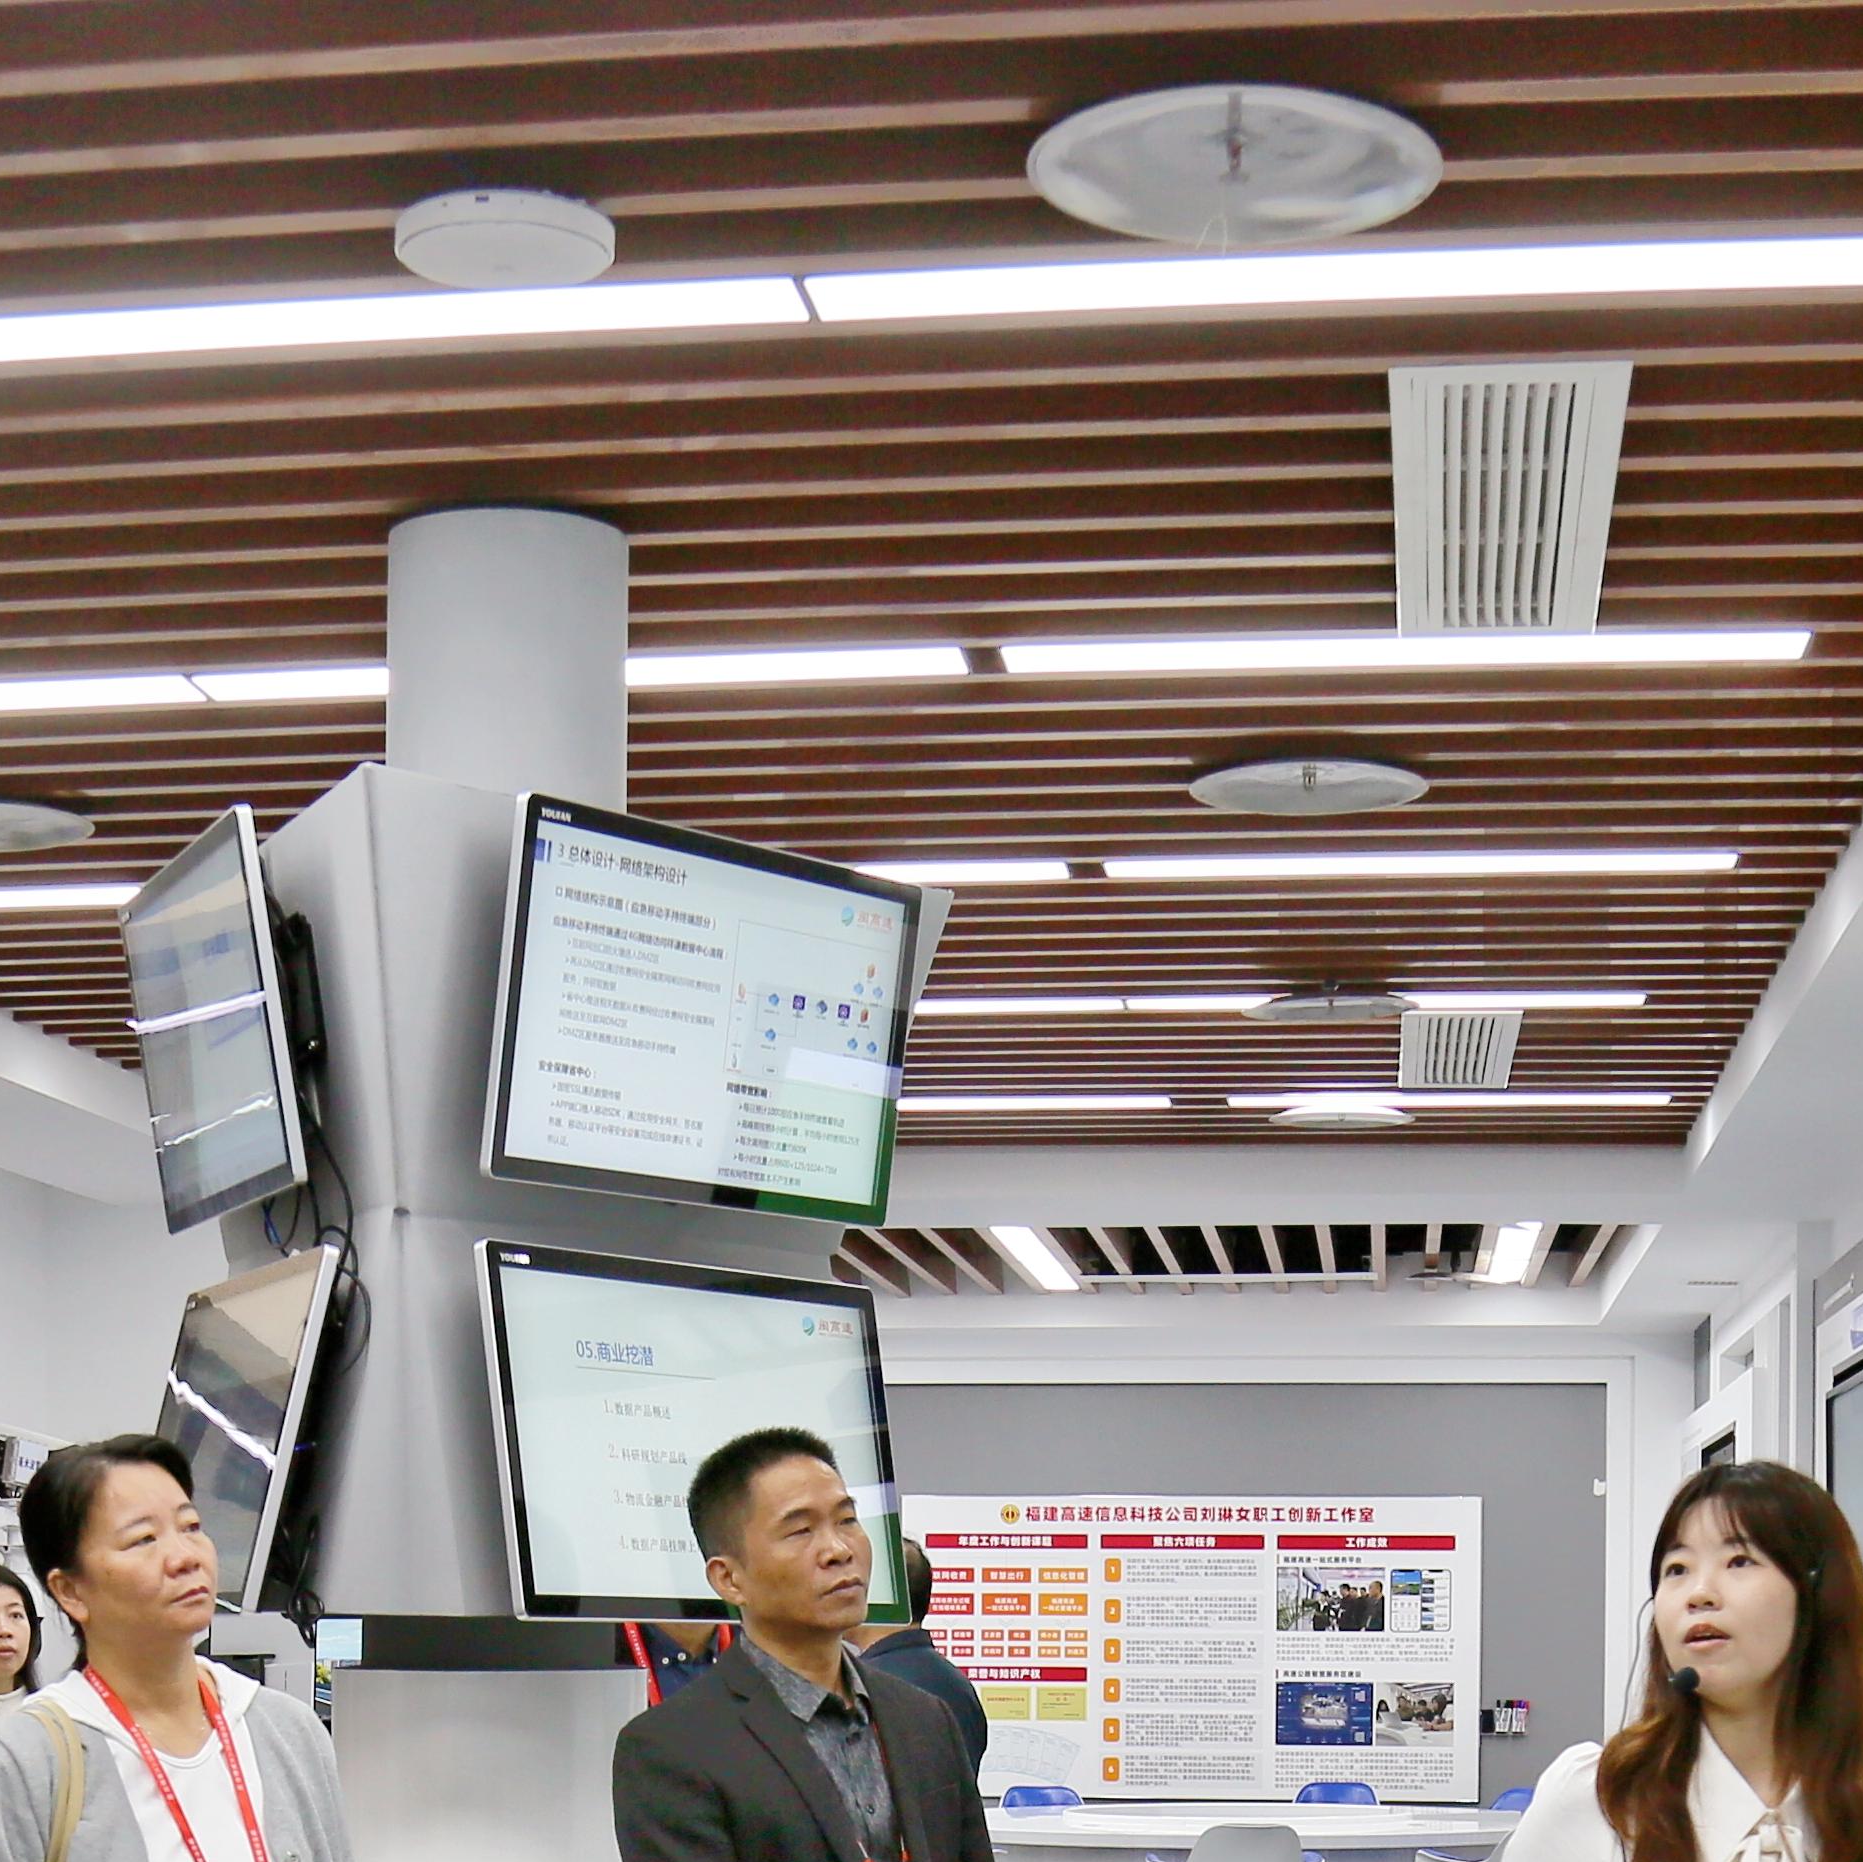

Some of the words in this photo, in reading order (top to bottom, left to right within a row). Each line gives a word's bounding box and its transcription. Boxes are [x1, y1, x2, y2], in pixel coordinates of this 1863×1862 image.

[569, 847, 688, 886] 总体设计-网络架构设计
[576, 1340, 654, 1367] 05.商业挖潜
[1026, 1505, 1375, 1524] 福建高速信息科技公司刘琳女职工创新工作室
[958, 1535, 1052, 1547] 年度工作与创新课题
[1152, 1535, 1216, 1549] 聚焦六项任务
[1344, 1536, 1388, 1548] 工作成效
[990, 1570, 1025, 1581] 智慧出行
[1109, 1565, 1116, 1575] 1
[1109, 1605, 1116, 1616] 2
[1108, 1645, 1116, 1655] 3
[967, 1667, 1041, 1680] 荣誉与知识产权
[1107, 1685, 1116, 1695] 4
[1107, 1726, 1115, 1735] 5
[1107, 1764, 1115, 1774] 6
